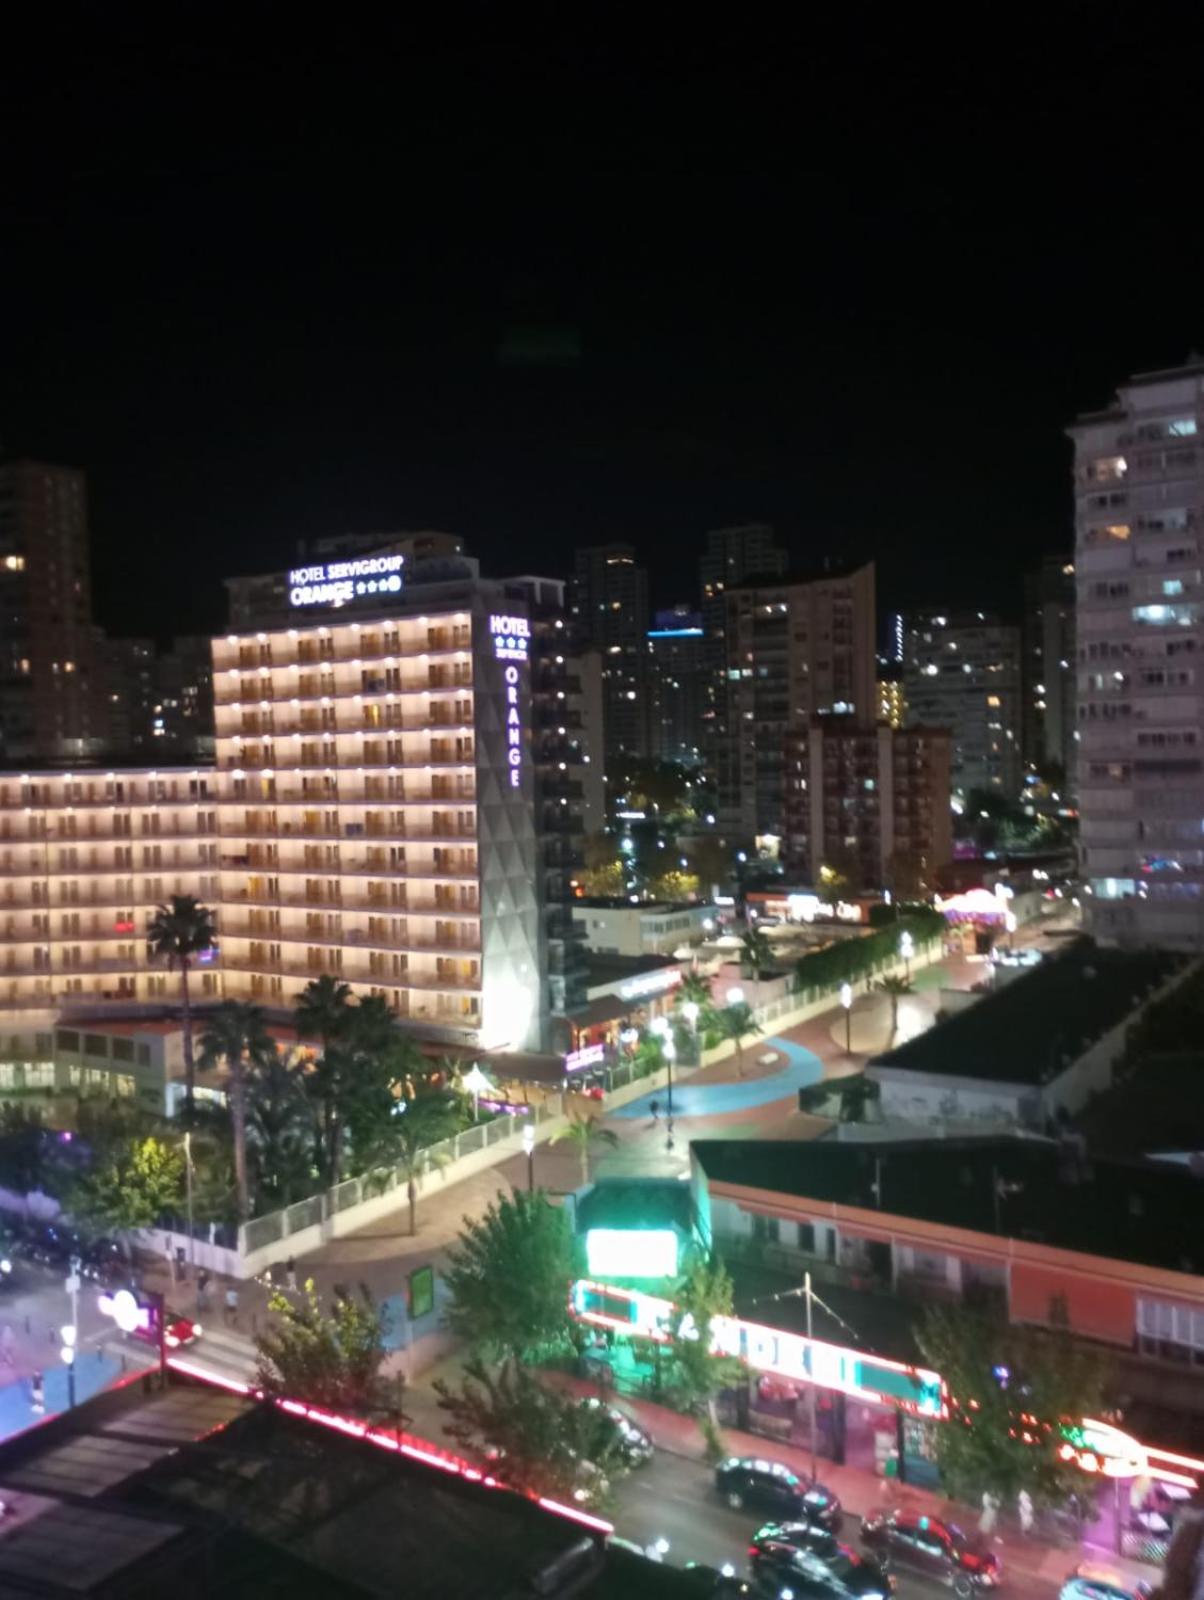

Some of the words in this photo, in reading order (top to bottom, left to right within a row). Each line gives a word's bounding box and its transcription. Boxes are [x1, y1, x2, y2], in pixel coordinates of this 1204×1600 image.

[290, 566, 326, 584] HOTEL
[327, 555, 404, 579] SERVIGROUP
[290, 581, 354, 606] ORANGE
[490, 614, 531, 637] HOTEL
[505, 665, 521, 787] ORANGE
